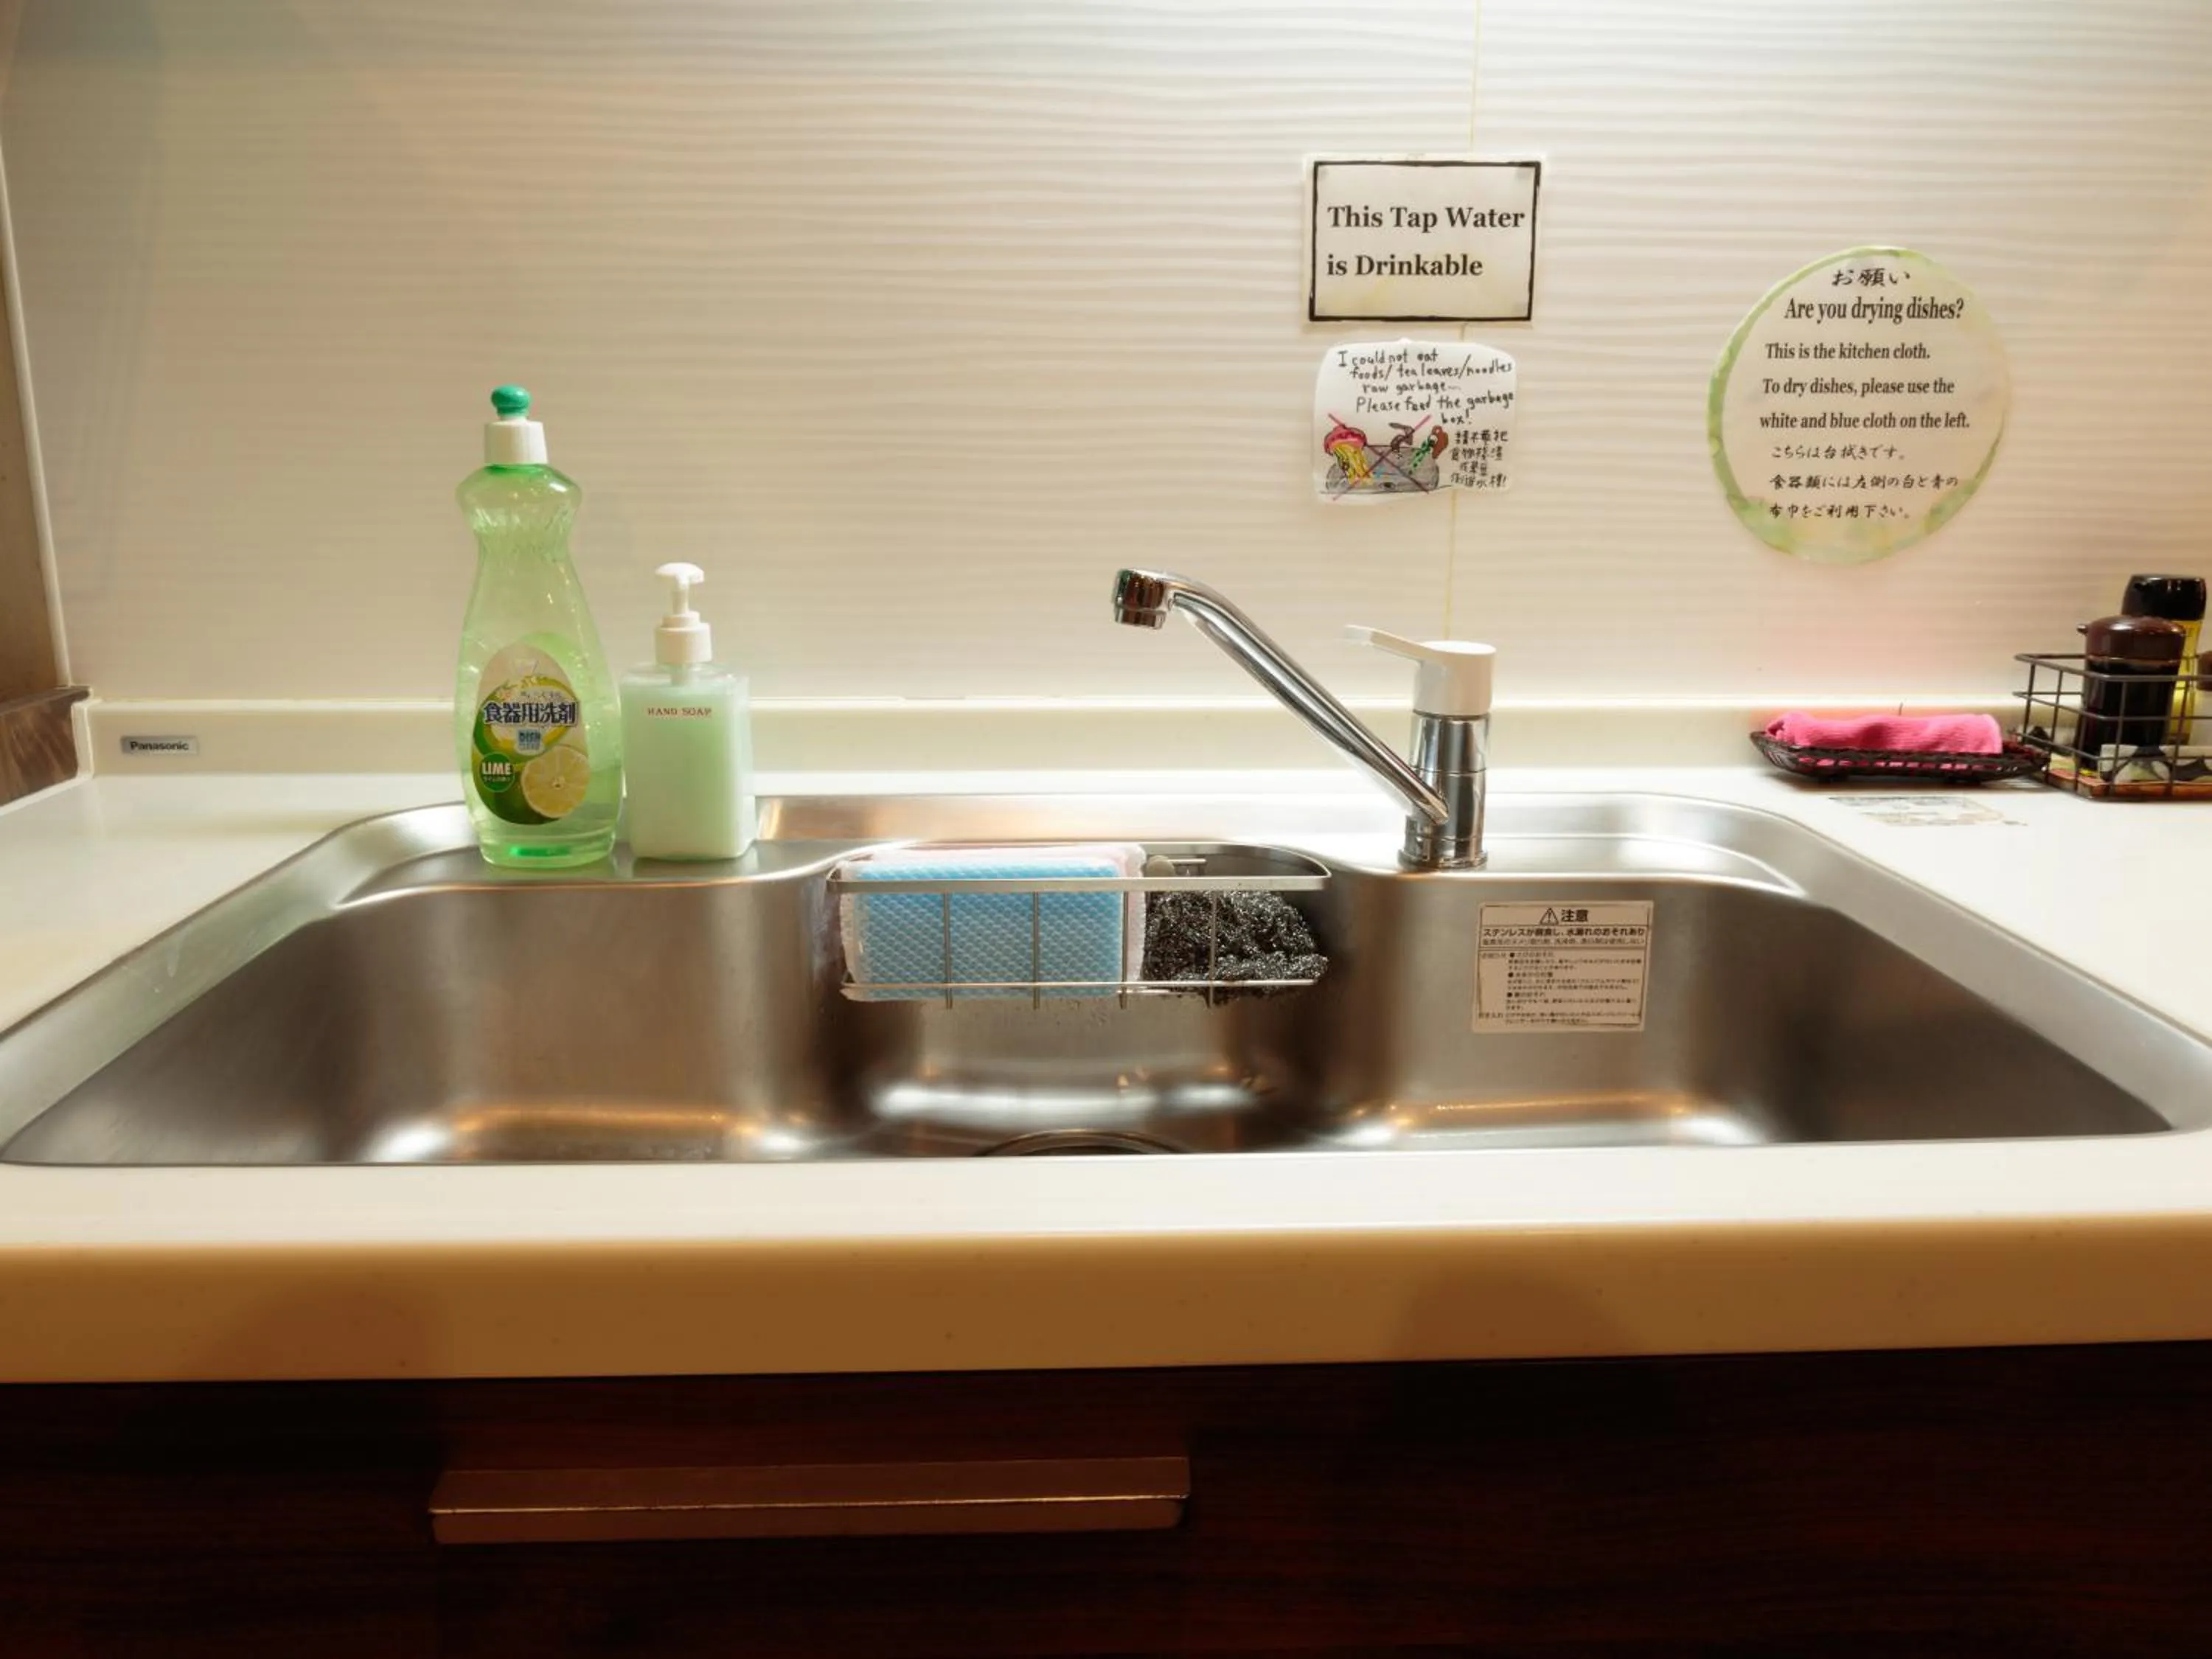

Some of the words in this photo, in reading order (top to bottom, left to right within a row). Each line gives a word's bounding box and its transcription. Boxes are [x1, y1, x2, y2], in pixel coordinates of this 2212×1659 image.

[1327, 205, 1382, 228] This
[1390, 206, 1438, 233] Tap
[1445, 206, 1526, 228] Water
[1327, 254, 1347, 276] is
[1355, 254, 1484, 276] Drinkable
[1832, 268, 1911, 287] お願い
[1784, 298, 1815, 319] Are
[1818, 302, 1846, 324] you
[1851, 296, 1902, 324] drying
[1906, 296, 1964, 319] dishes?
[1338, 350, 1348, 367] I
[1352, 349, 1385, 366] could
[1388, 348, 1408, 364] not
[1416, 347, 1439, 362] eat
[1765, 343, 1795, 359] This
[1798, 343, 1810, 359] is
[1814, 343, 1835, 359] the
[1839, 343, 1890, 359] kitchen
[1893, 343, 1931, 359] cloth.
[1362, 383, 1388, 394] raw
[1763, 378, 1780, 394] To
[1784, 378, 1806, 397] dry
[1809, 378, 1857, 397] dishes,
[1861, 378, 1905, 397] please
[1907, 381, 1930, 394] use
[1933, 378, 1955, 394] the
[1357, 396, 1400, 413] Please
[1436, 395, 1461, 409] the
[1467, 389, 1514, 409] garbage
[1760, 412, 1797, 428] white
[1800, 412, 1826, 428] and
[1829, 412, 1860, 428] blue
[1863, 412, 1897, 428] cloth
[1900, 417, 1917, 428] on
[1920, 412, 1941, 428] the
[1944, 412, 1970, 428] left.
[1771, 444, 1905, 460] こちらは台拭きです。
[1770, 473, 1958, 490] 食器類には左側の白と青の
[1770, 503, 1910, 519] 布巾をご利用下さい。
[483, 701, 577, 724] 食器用洗剤
[647, 707, 678, 716] HAND
[682, 707, 712, 717] SOAP
[129, 740, 189, 751] Panasonic
[481, 762, 512, 776] LIME
[1560, 908, 1589, 922] 注意
